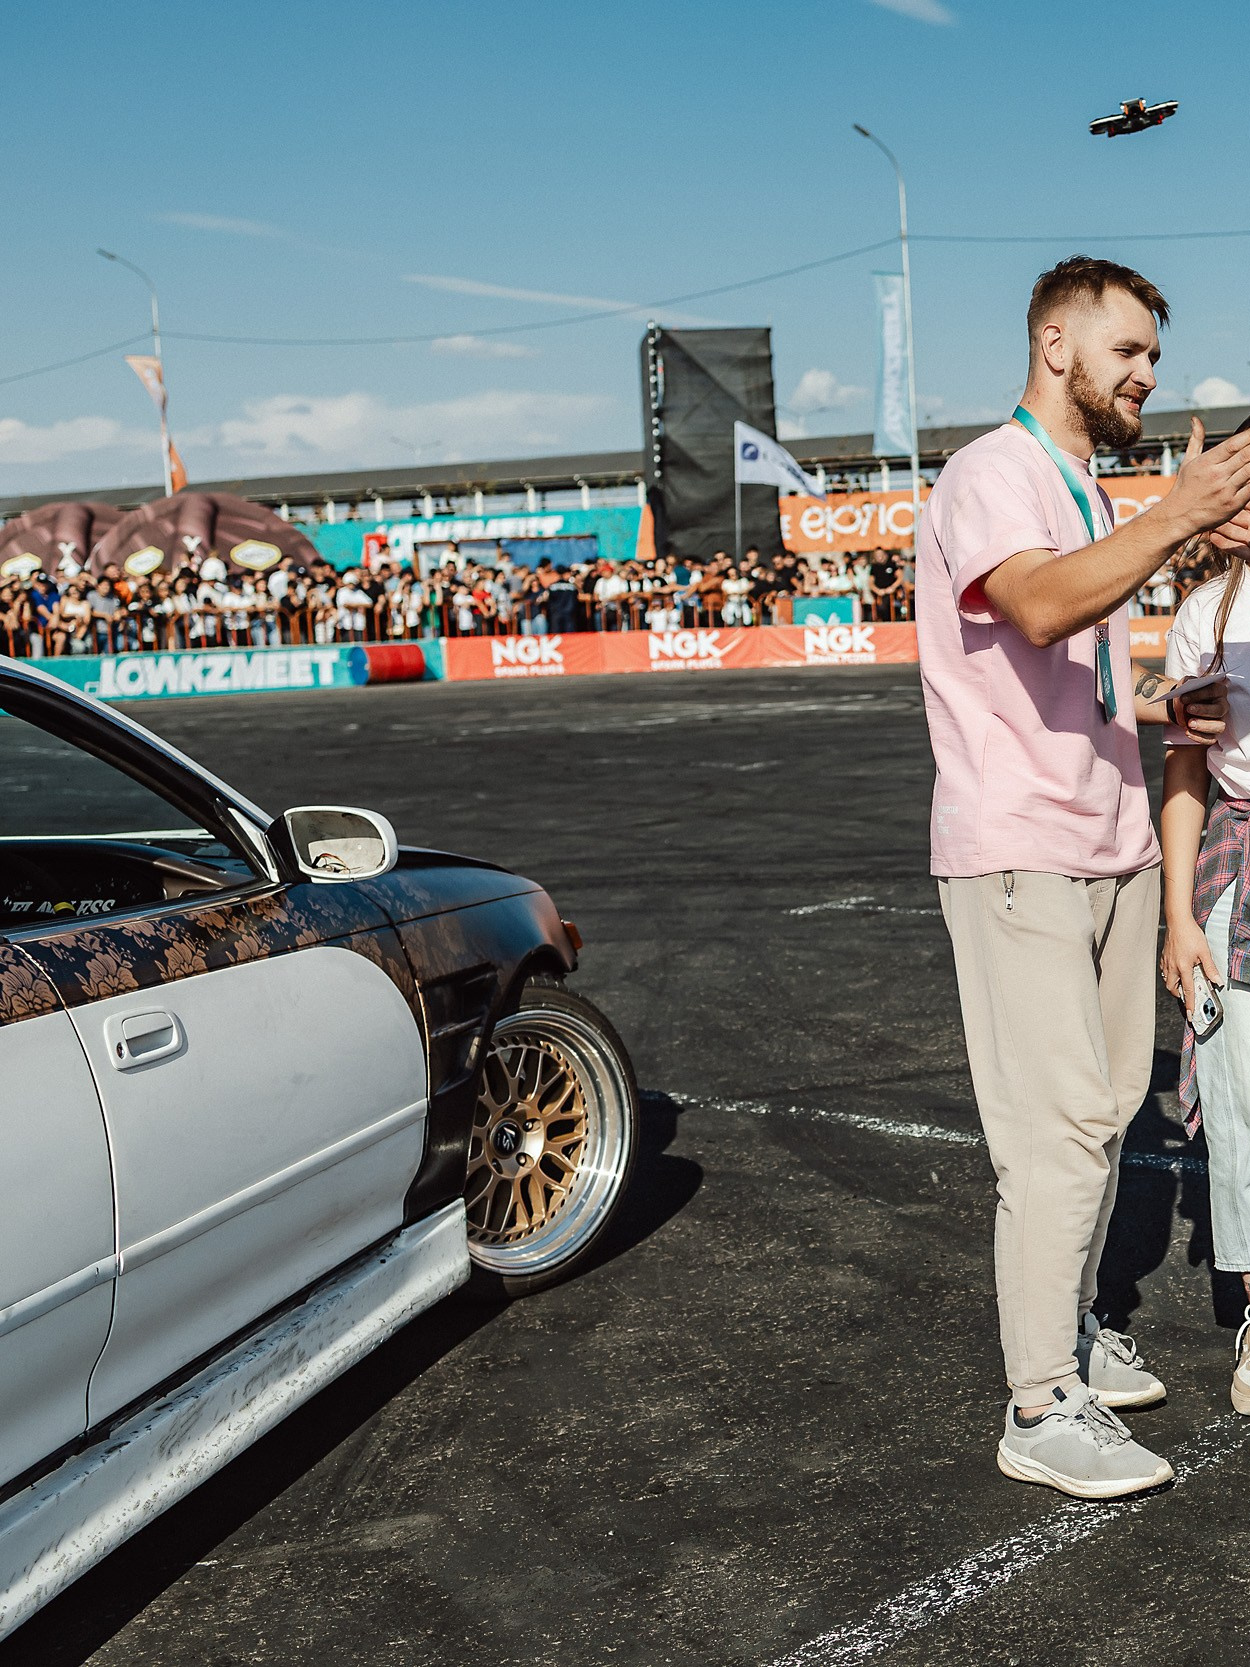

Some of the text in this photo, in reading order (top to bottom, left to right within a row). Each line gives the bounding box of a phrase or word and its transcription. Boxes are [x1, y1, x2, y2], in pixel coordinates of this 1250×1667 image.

[491, 635, 564, 665] NGK
[648, 629, 721, 659] NGK
[804, 625, 876, 653] NGK
